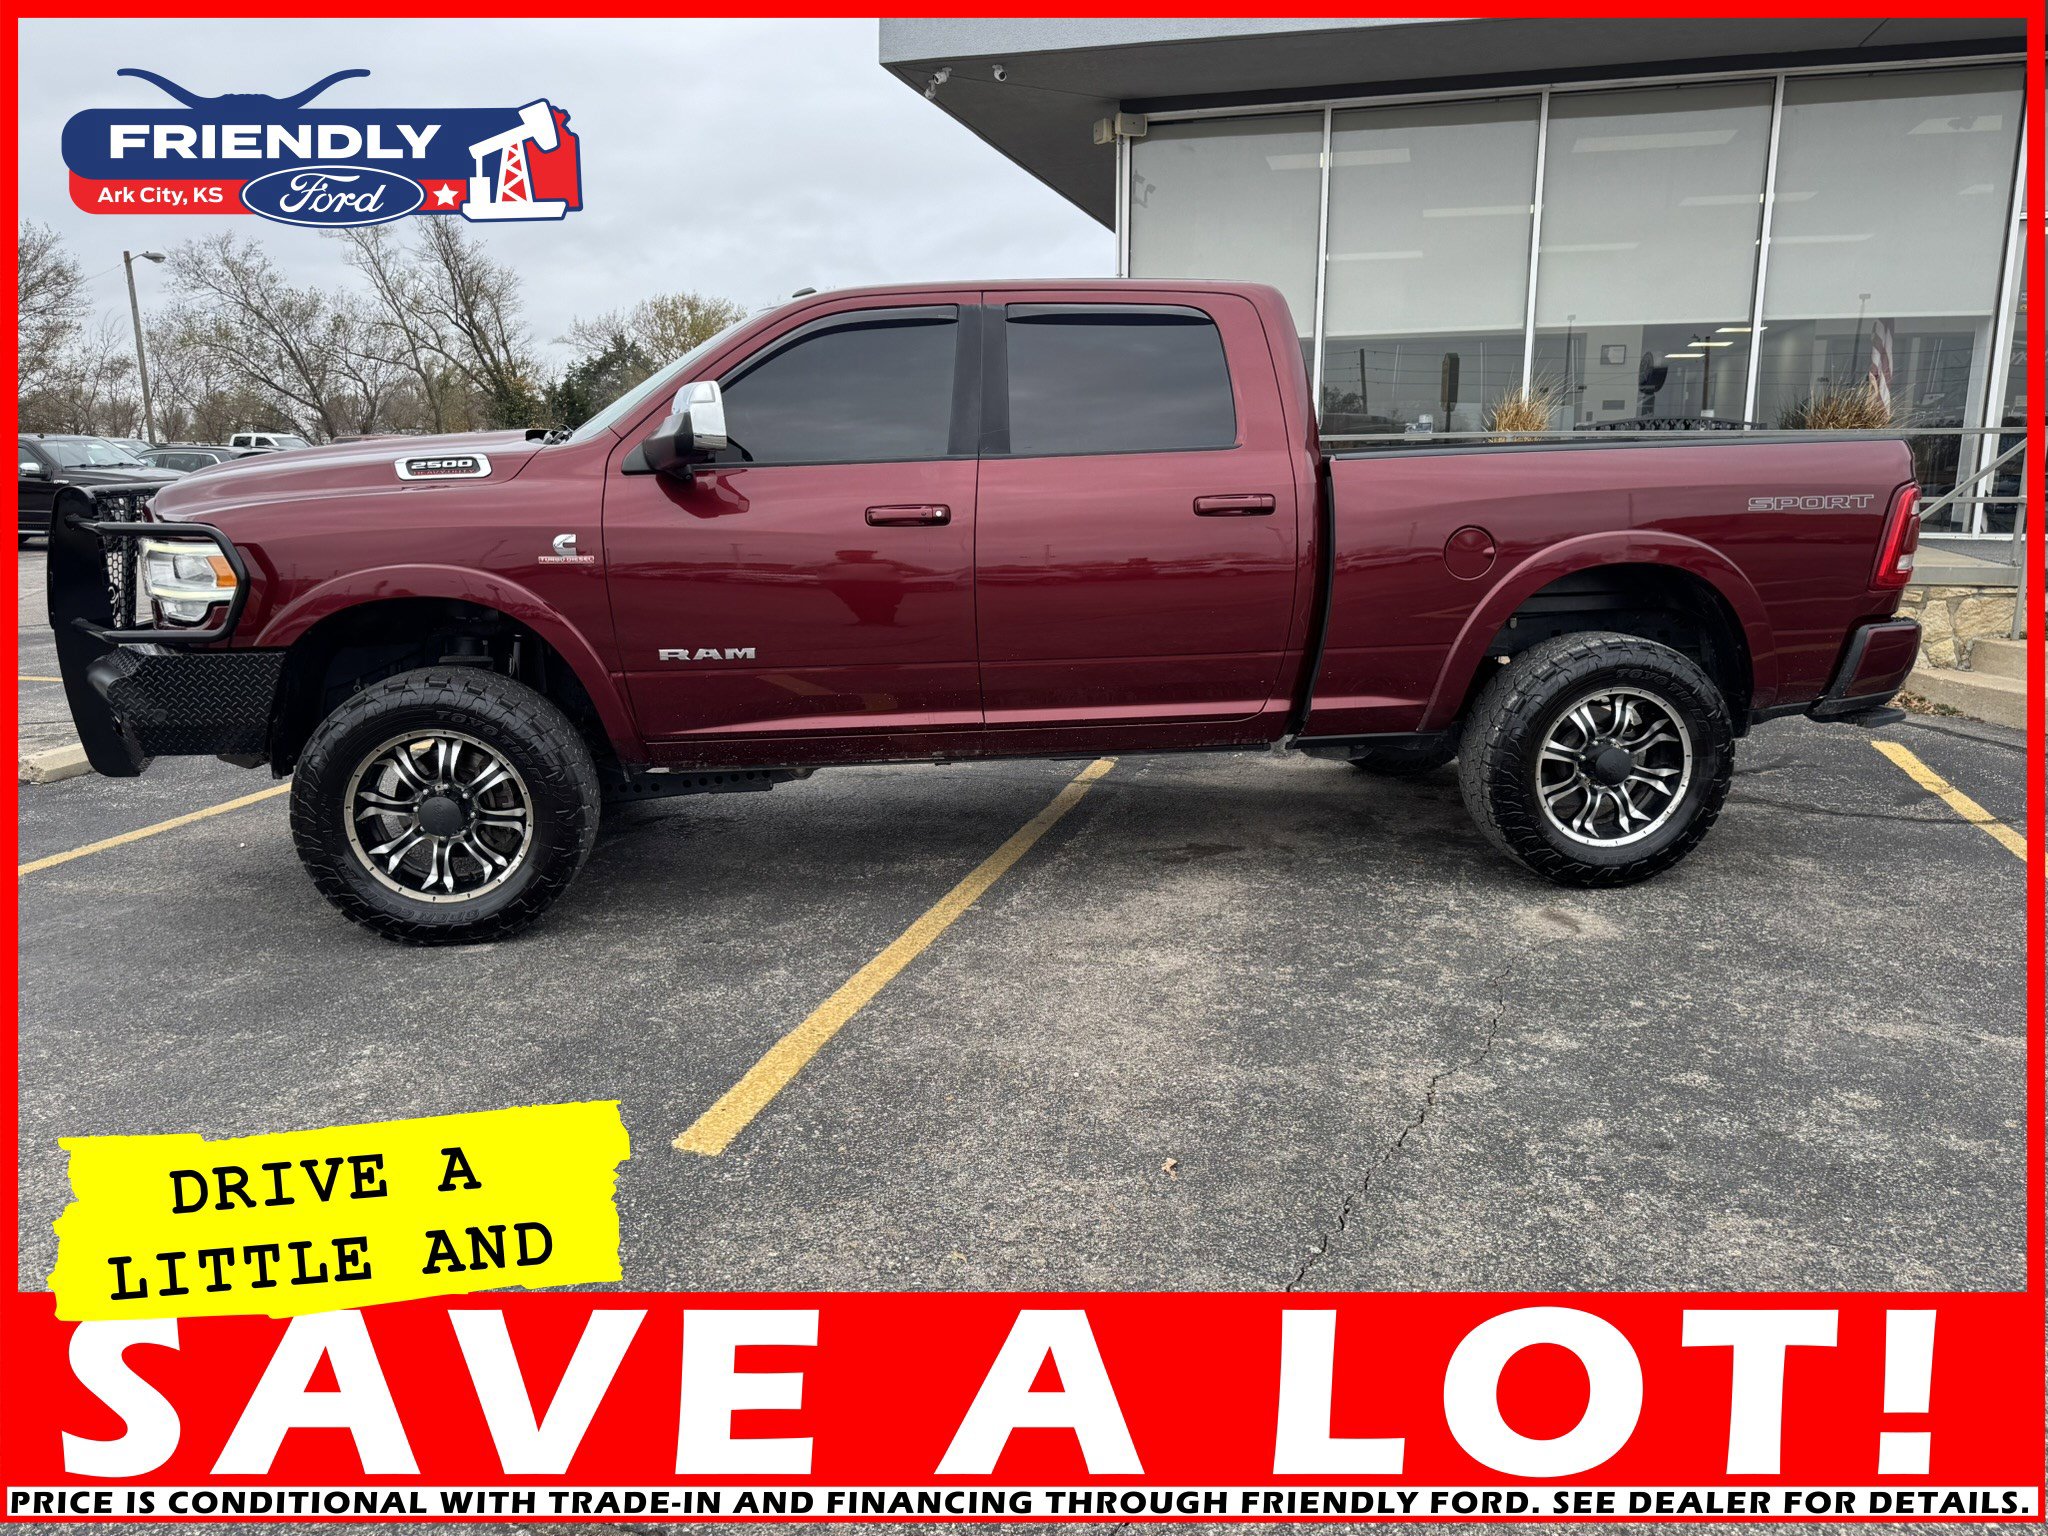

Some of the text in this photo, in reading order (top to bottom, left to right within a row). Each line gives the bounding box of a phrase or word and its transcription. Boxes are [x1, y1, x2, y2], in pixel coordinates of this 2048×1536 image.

[411, 460, 473, 469] 2500
[1748, 494, 1874, 511] SPORT
[658, 648, 756, 660] RAM
[436, 710, 499, 736] TOYO
